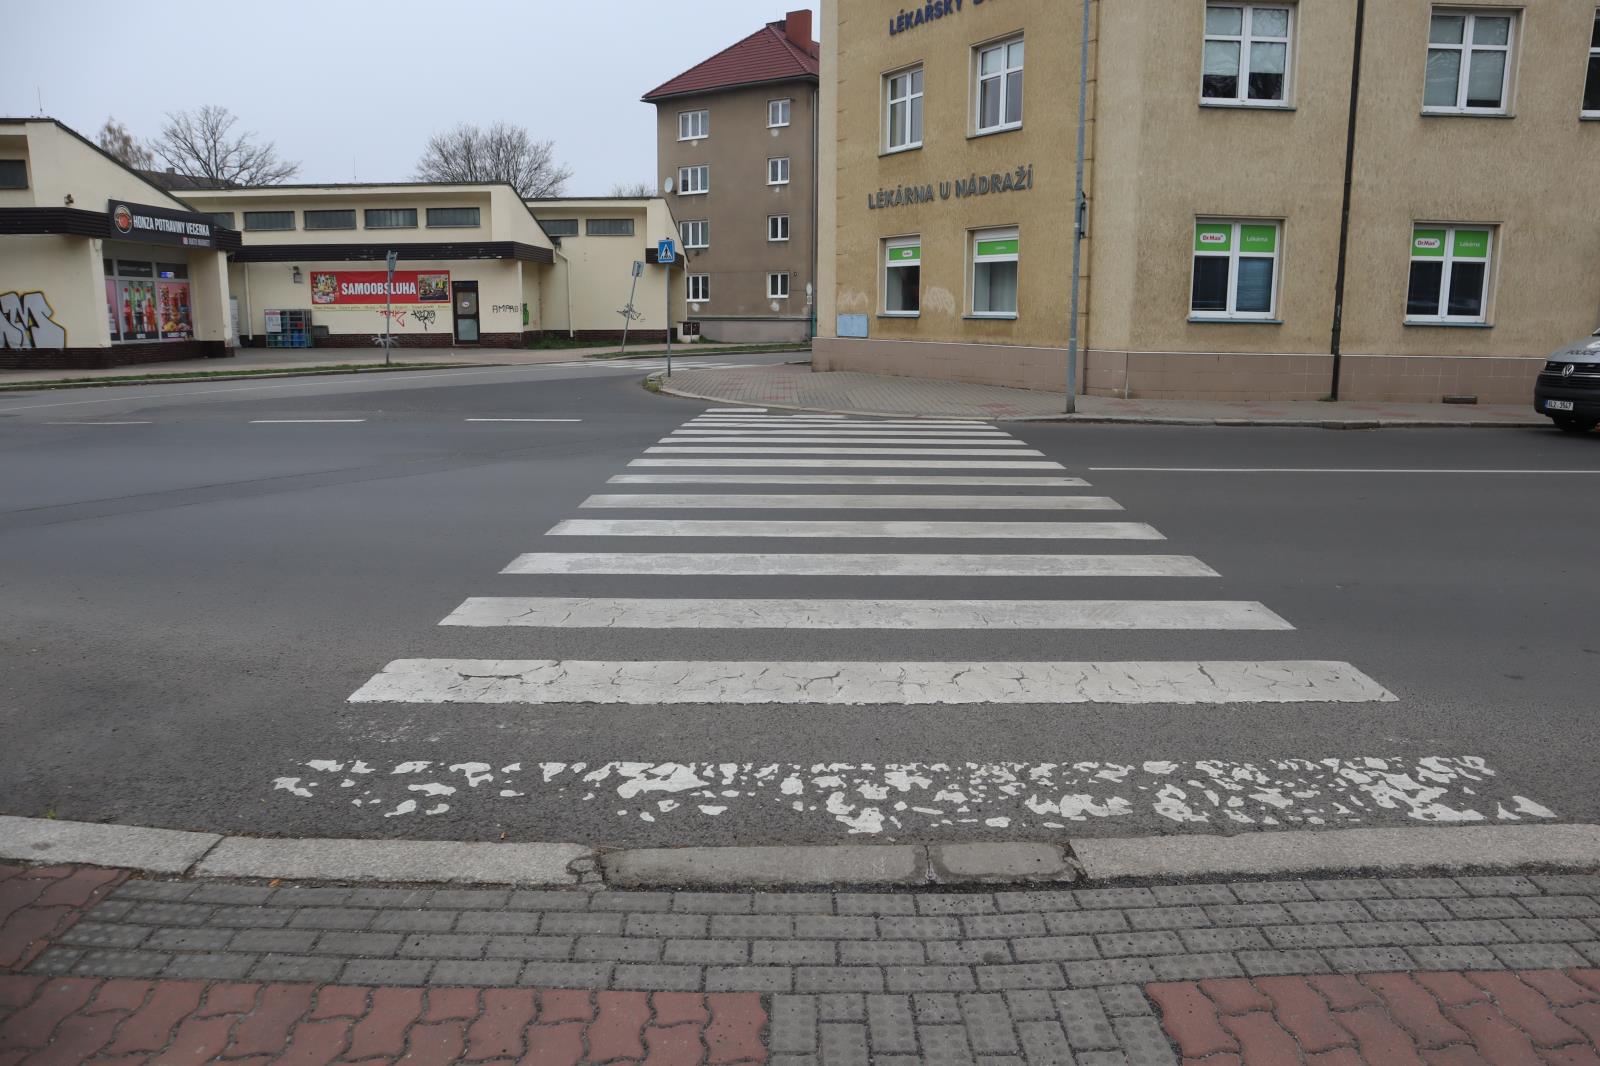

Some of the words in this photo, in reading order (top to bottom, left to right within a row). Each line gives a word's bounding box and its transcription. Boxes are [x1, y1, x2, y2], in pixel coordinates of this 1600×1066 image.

[867, 185, 934, 209] LÉKÁRNA
[939, 180, 950, 200] U
[955, 163, 1033, 198] NÁDRAŽÍ
[133, 216, 154, 230] HONZA
[155, 218, 185, 233] POTRAVINY
[342, 282, 416, 295] SAMOOBSLUHA
